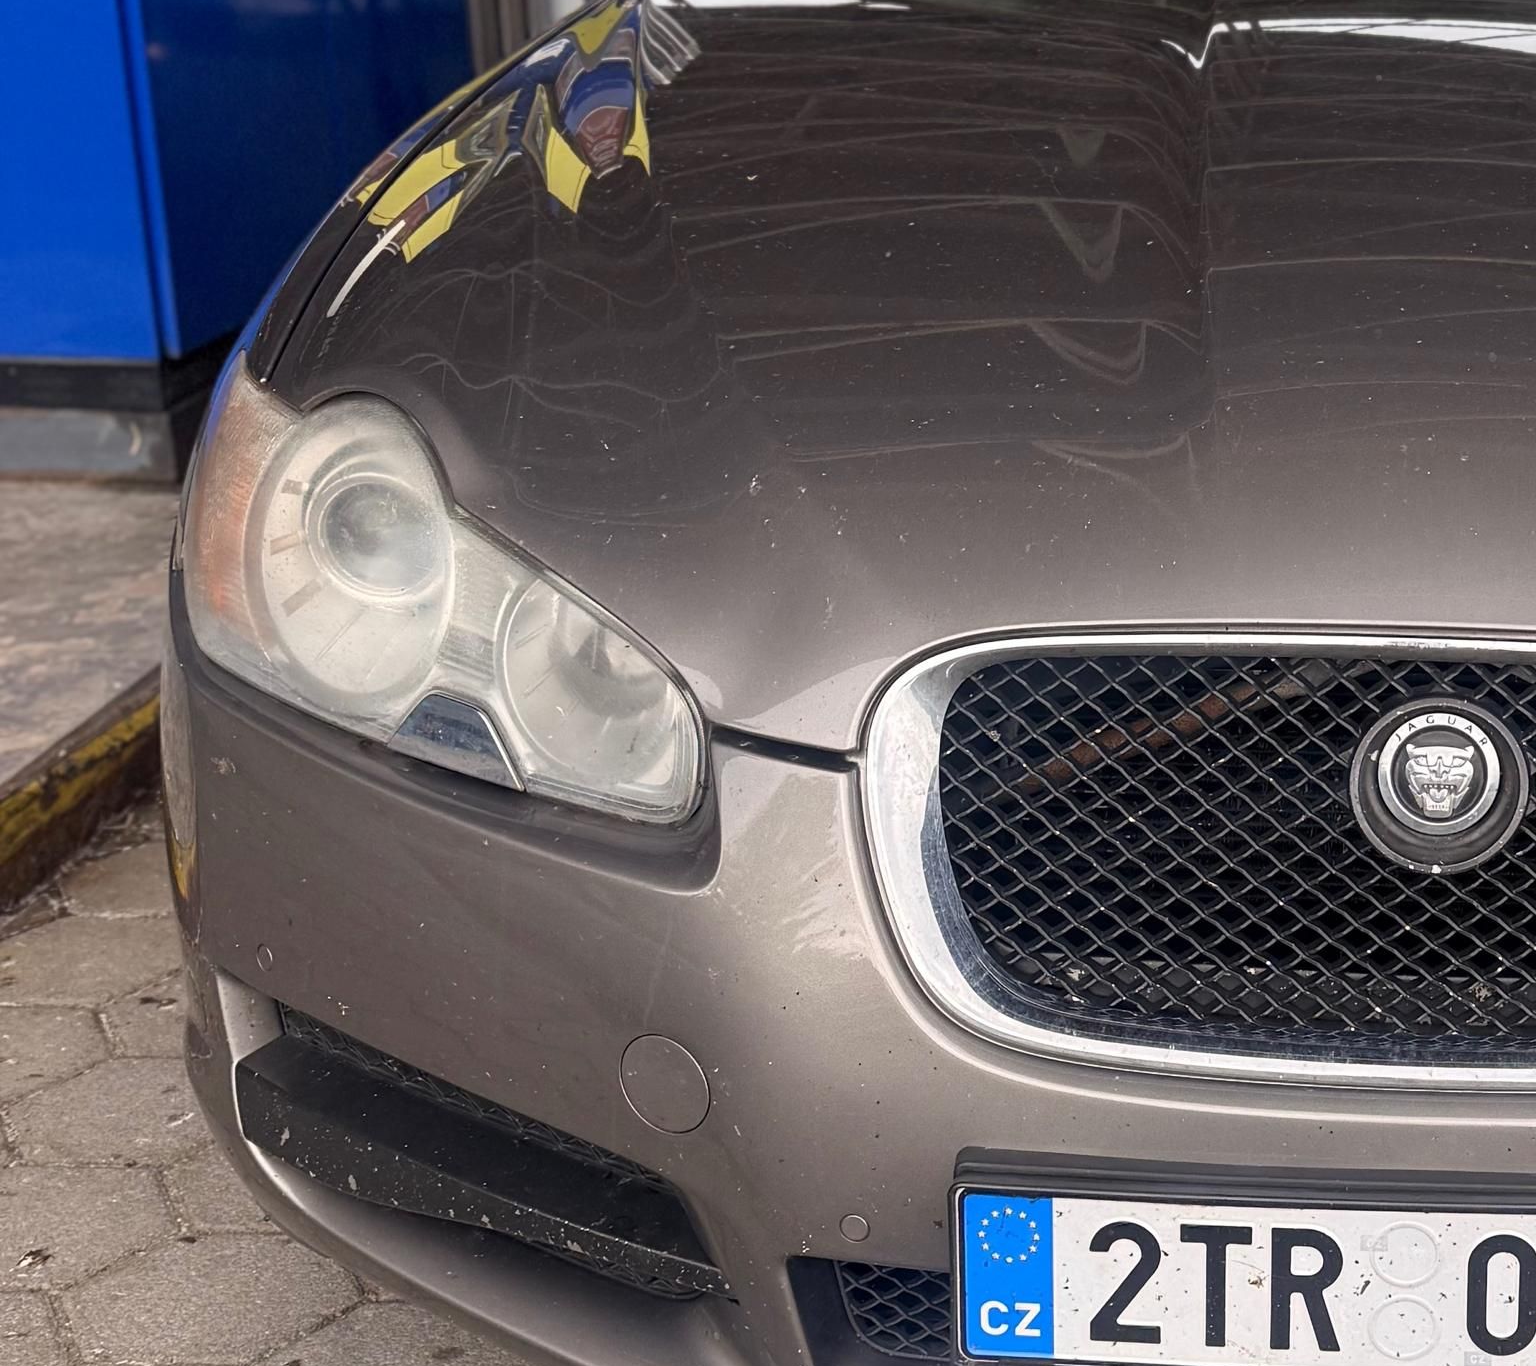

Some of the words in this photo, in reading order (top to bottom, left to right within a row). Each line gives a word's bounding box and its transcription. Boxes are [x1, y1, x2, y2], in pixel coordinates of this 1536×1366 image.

[1395, 714, 1489, 748] JAGUAR
[1089, 1221, 1344, 1352] 2TR
[980, 1300, 1041, 1337] CZ
